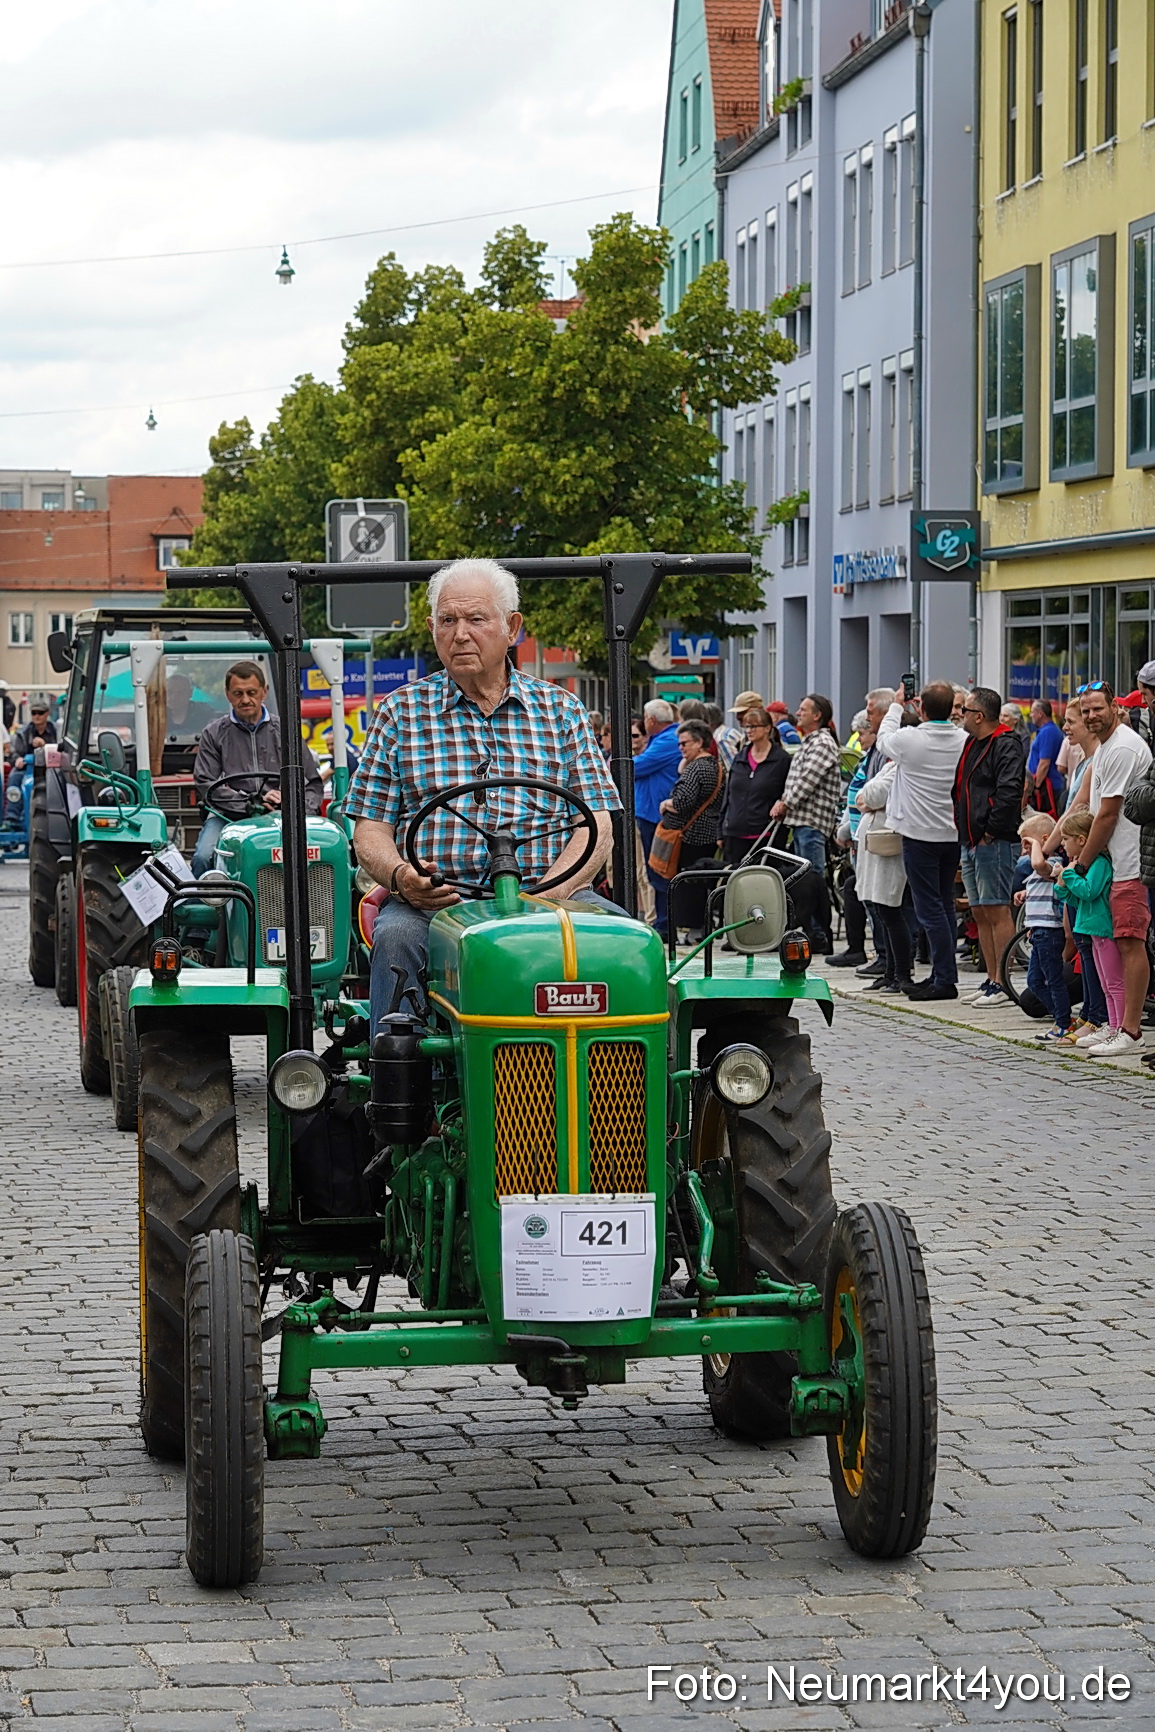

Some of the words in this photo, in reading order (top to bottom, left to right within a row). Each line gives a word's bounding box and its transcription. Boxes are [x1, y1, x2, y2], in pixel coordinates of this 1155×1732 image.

[936, 529, 960, 559] G2
[272, 848, 319, 861] Ker
[544, 985, 600, 1012] Bautz
[579, 1220, 627, 1245] 421
